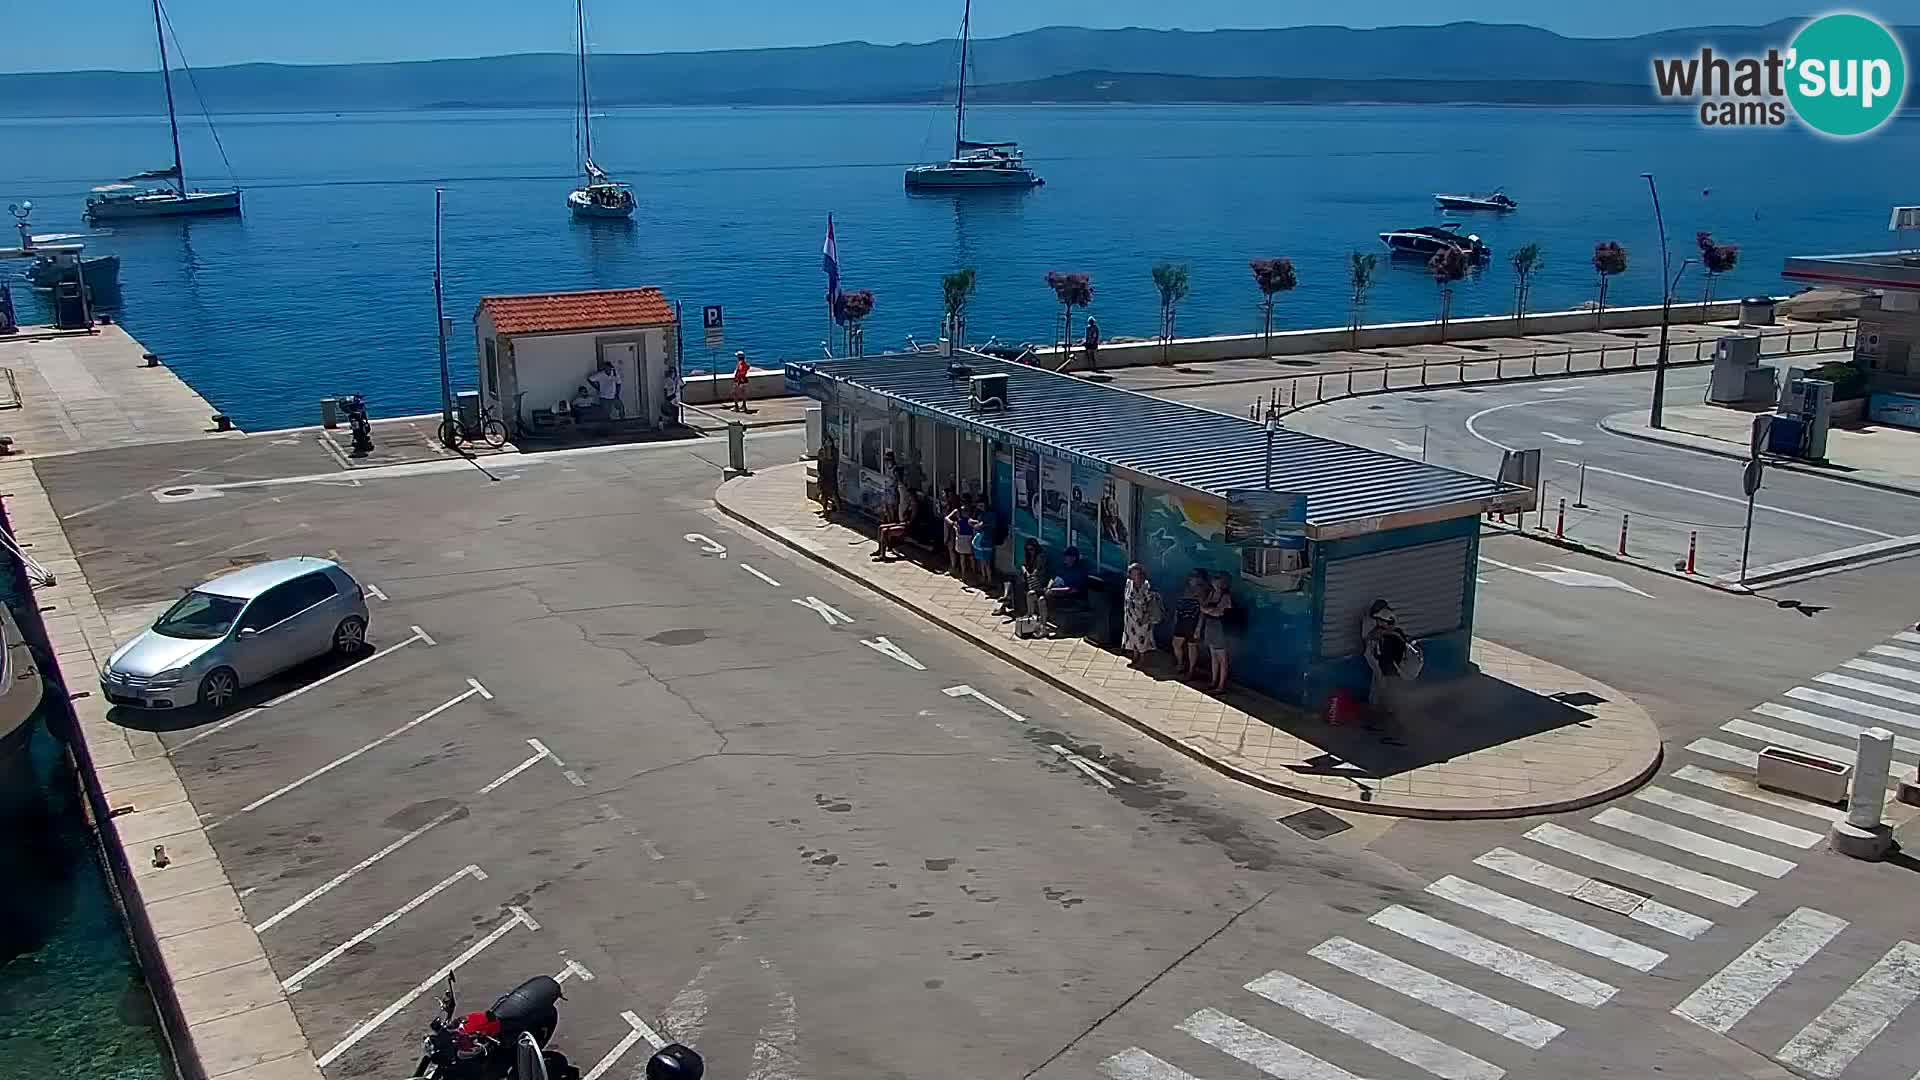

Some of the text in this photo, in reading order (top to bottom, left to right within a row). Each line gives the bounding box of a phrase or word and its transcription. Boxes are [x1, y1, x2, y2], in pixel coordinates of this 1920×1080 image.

[707, 308, 718, 325] P
[1024, 440, 1054, 457] STATION
[1081, 457, 1107, 472] OFFICE
